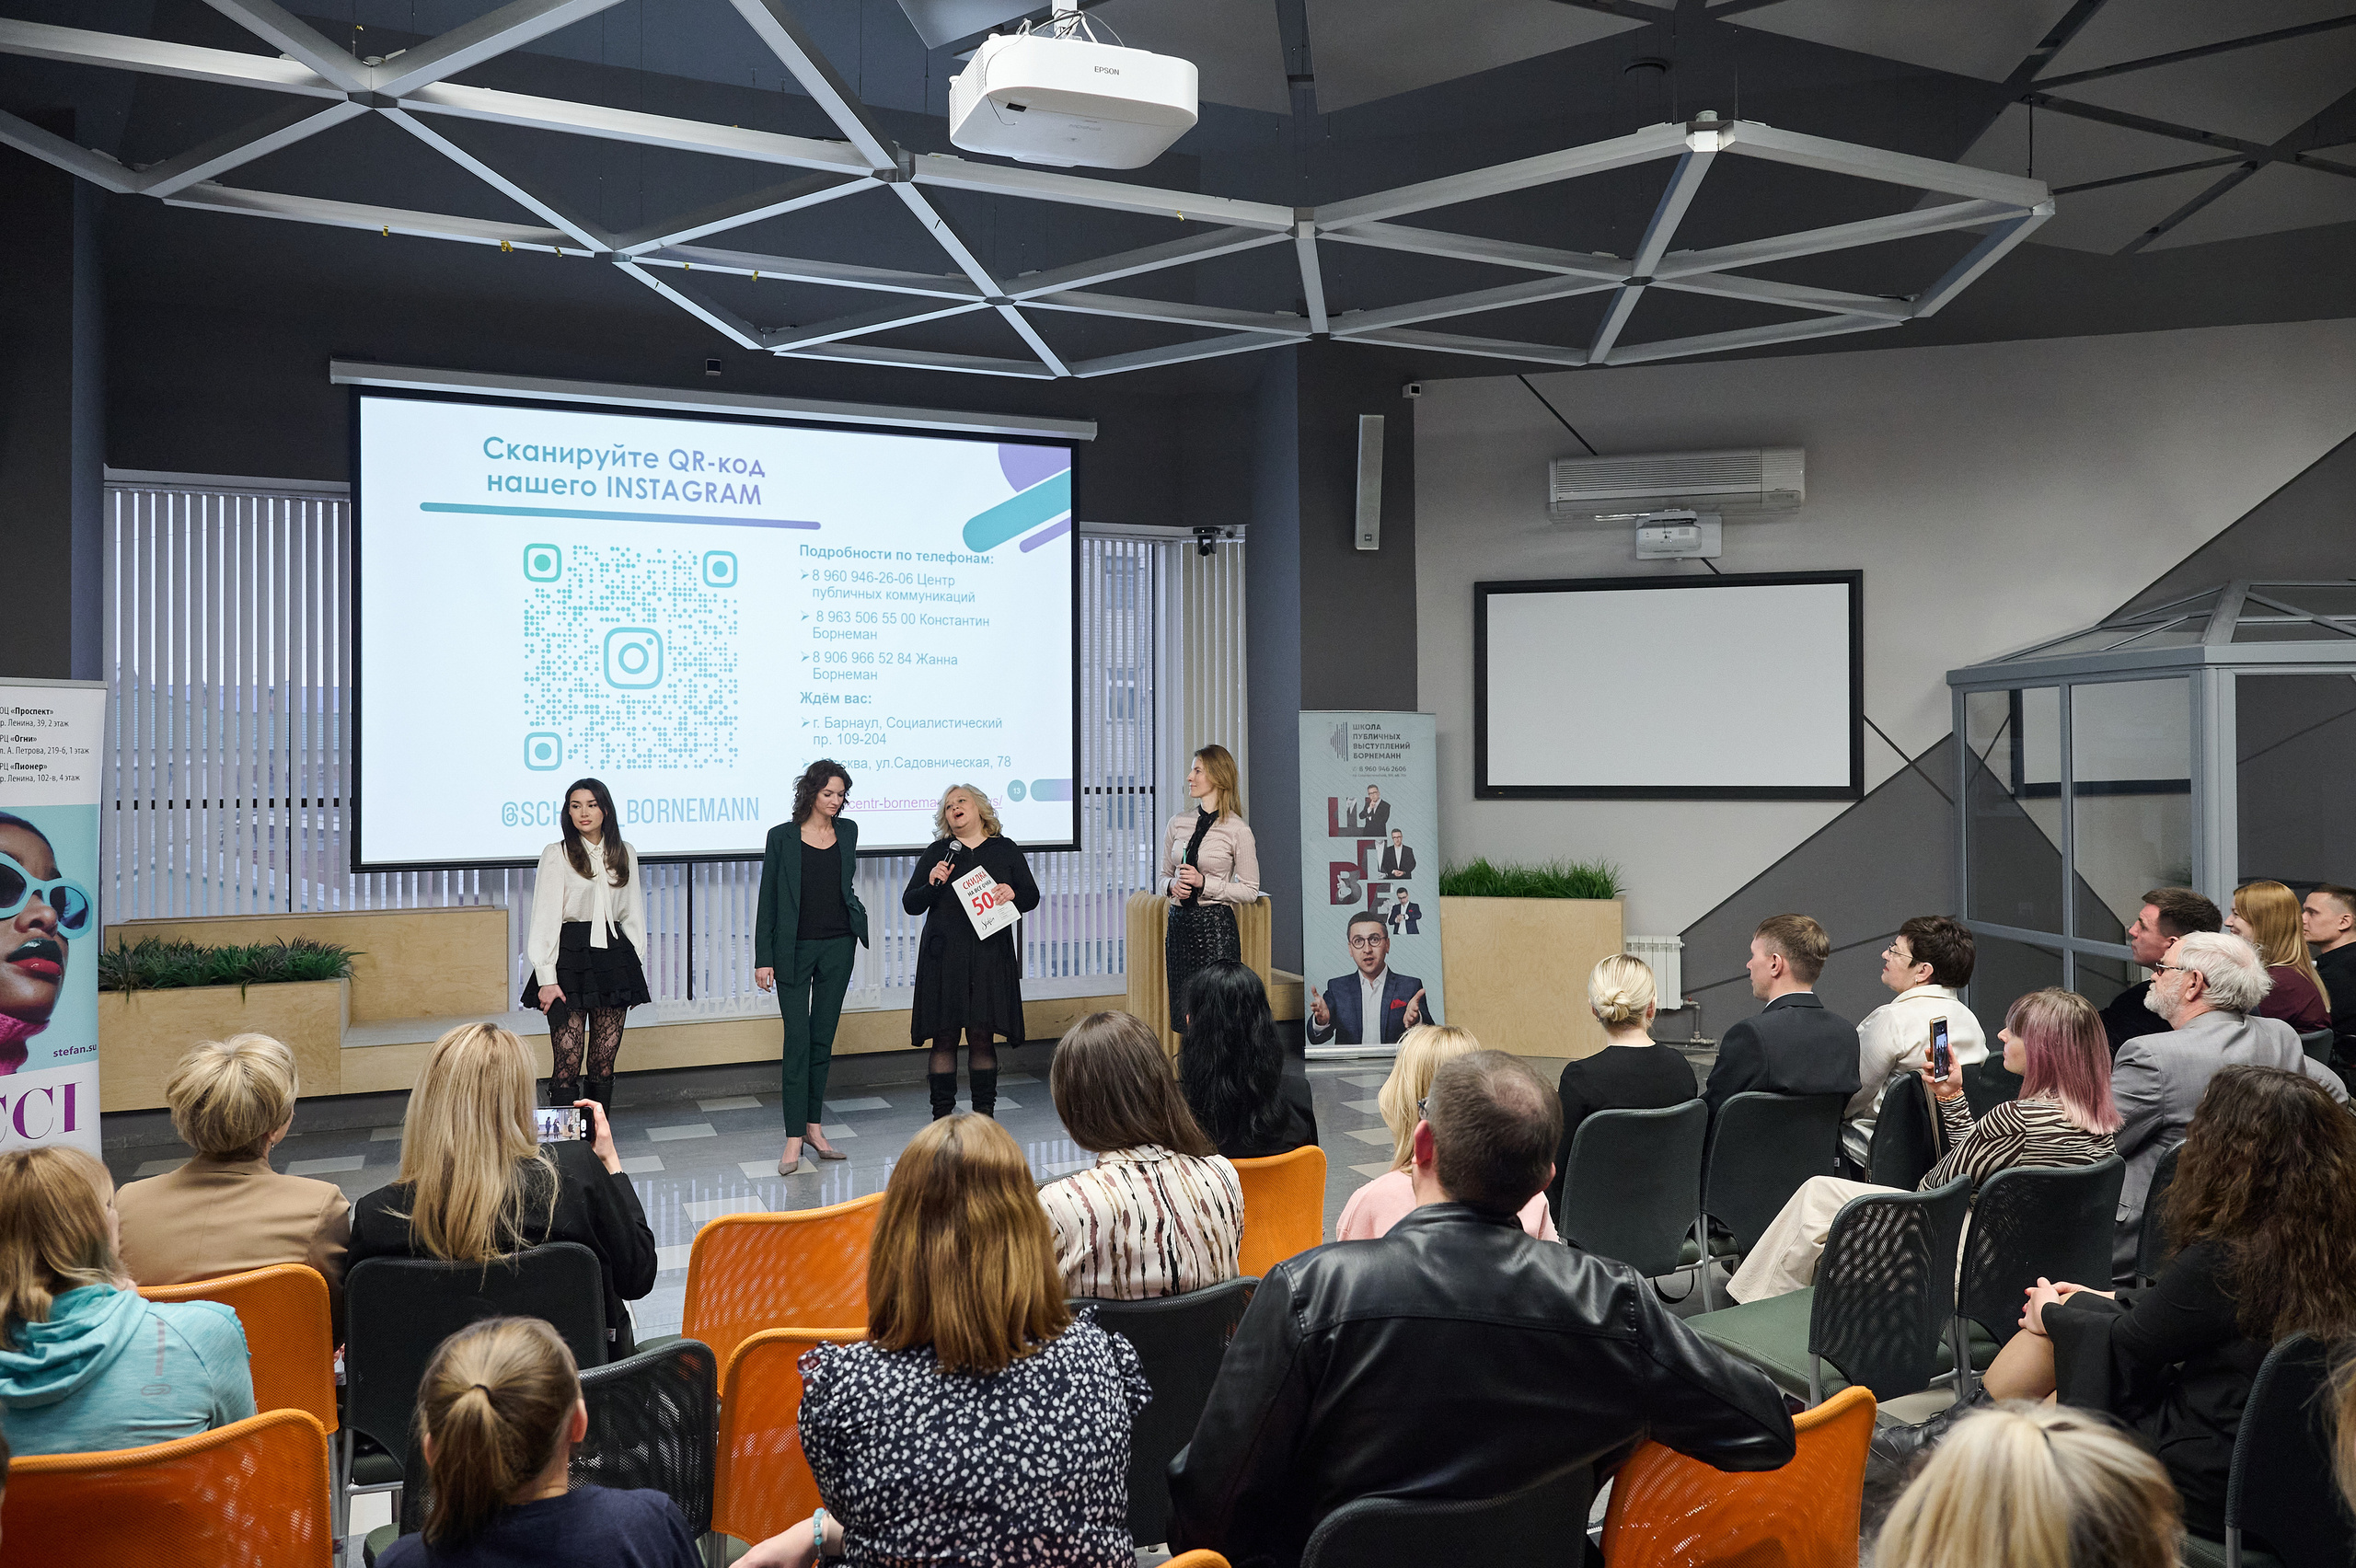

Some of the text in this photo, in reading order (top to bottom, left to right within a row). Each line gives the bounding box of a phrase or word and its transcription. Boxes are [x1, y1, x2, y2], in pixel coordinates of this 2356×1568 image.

[1094, 65, 1120, 75] EPSON
[483, 436, 766, 478] Сканируйте QR-код
[487, 474, 762, 505] нашего INSTAGRAM
[800, 544, 994, 565] Подробности по телефонам:
[813, 569, 955, 588] 8 960 946-26-06 Центр
[813, 586, 976, 604] публичных коммуникаций
[816, 610, 989, 627] 8 963 506 55 00 Константин
[813, 627, 878, 641] Борнеман
[813, 651, 958, 665] 8 906 966 52 84 Жанна
[813, 667, 878, 683] Борнеман
[800, 691, 872, 706] Ждём вас:
[11, 707, 54, 716] «Проспект»
[7, 719, 36, 727] Ленина,
[813, 716, 1002, 732] г. Барнаул, Социалистический
[10, 734, 37, 743] «Огни»
[813, 733, 886, 748] пр. 109-204
[1353, 741, 1411, 750] ВЫСТУПЛЕНИЙ
[6, 746, 14, 755] А.
[15, 746, 46, 755] Петрова,
[10, 762, 48, 771] «Пионер»
[998, 755, 1011, 768] 78
[7, 774, 36, 782] Ленина,
[37, 774, 58, 782] 102-в,
[1013, 787, 1022, 795] 13
[502, 797, 759, 828] @SCH_BORNEMANN
[962, 870, 987, 890] СКИДКА
[972, 892, 994, 916] 50
[52, 1043, 98, 1058] stefan.su
